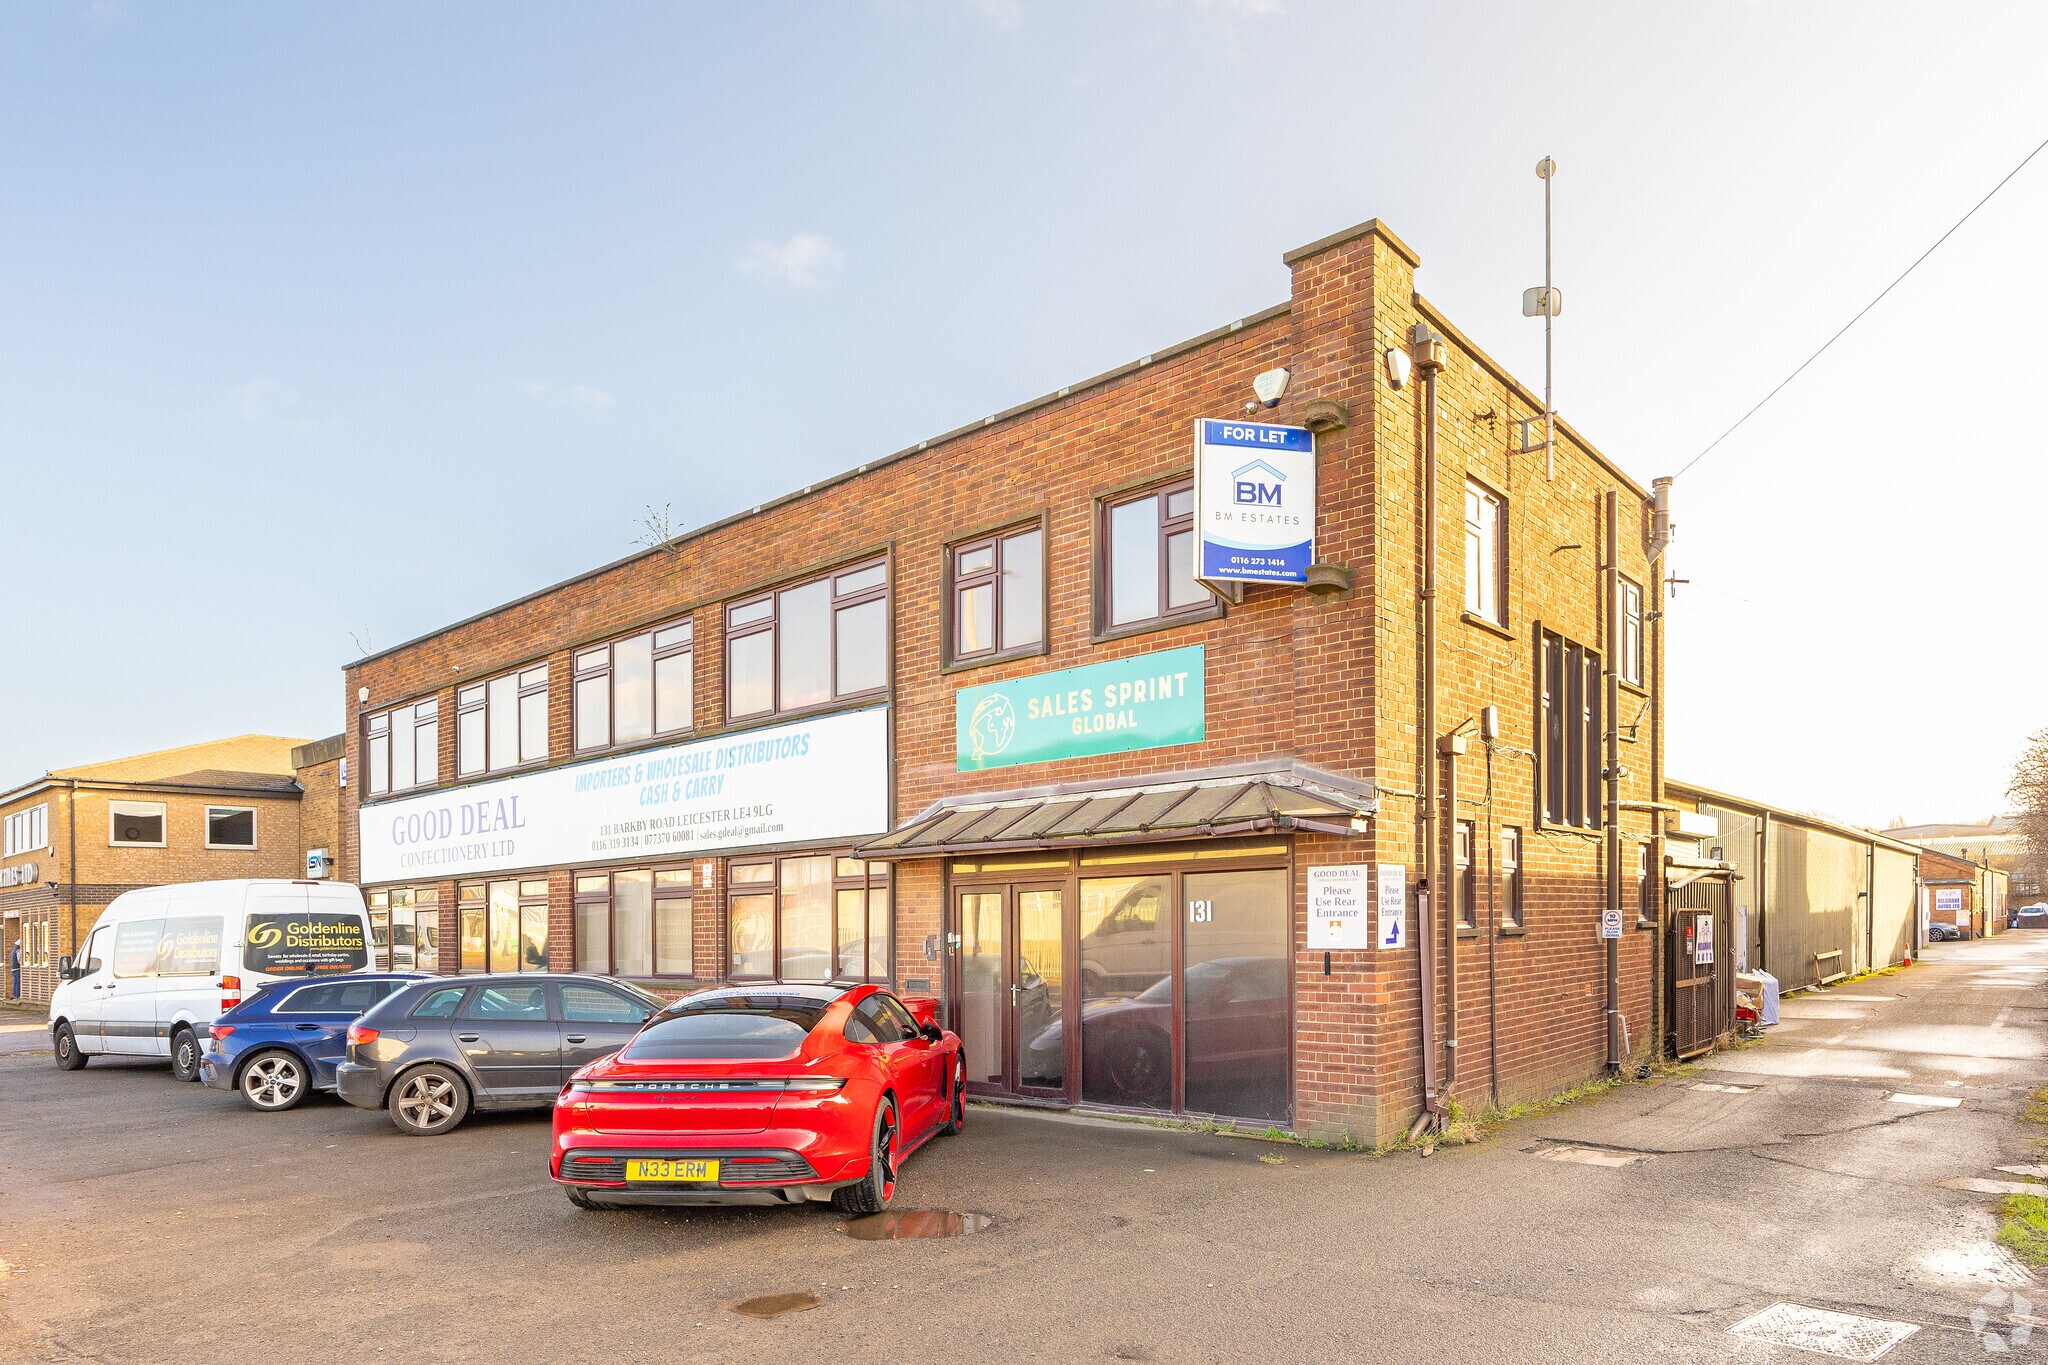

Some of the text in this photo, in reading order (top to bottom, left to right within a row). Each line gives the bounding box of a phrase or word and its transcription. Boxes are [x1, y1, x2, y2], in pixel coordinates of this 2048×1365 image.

[1223, 426, 1287, 444] FOR LET
[1236, 481, 1282, 505] BM
[1215, 511, 1300, 526] BM ESTATES
[1231, 556, 1285, 566] 0116 273 1414
[1218, 566, 1297, 578] www.bmestates.com
[1028, 671, 1188, 720] SALES SPRINT
[1072, 709, 1137, 735] GLOBAL
[574, 732, 810, 794] IMPORTERS & WHOLESALE DISTRIBUTORS
[640, 774, 725, 807] CASH & CARRY
[392, 794, 526, 846] GOOD DEAL
[600, 804, 773, 837] 131 BARKBY ROAD LEICESTER LE4 9LG
[591, 840, 607, 851] 0116
[609, 838, 621, 850] 319
[622, 836, 639, 847] 3134
[644, 833, 671, 846] 077370
[672, 830, 694, 843] 60081
[400, 839, 515, 868] CONFECTIONERY LTD
[1314, 869, 1361, 878] GOOD DEAL
[1323, 886, 1352, 895] Please
[1384, 885, 1399, 895] Please
[1315, 897, 1357, 906] Use Rear
[1381, 896, 1402, 905] Use Rear
[1189, 900, 1212, 923] 131
[1316, 909, 1358, 917] Entrance
[1381, 908, 1402, 917] Entrance
[287, 922, 361, 934] Goldenline
[177, 931, 219, 945] Goldenline
[286, 935, 363, 947] Distributors
[174, 946, 218, 959] Distributors
[638, 1161, 707, 1178] N33 ERM
